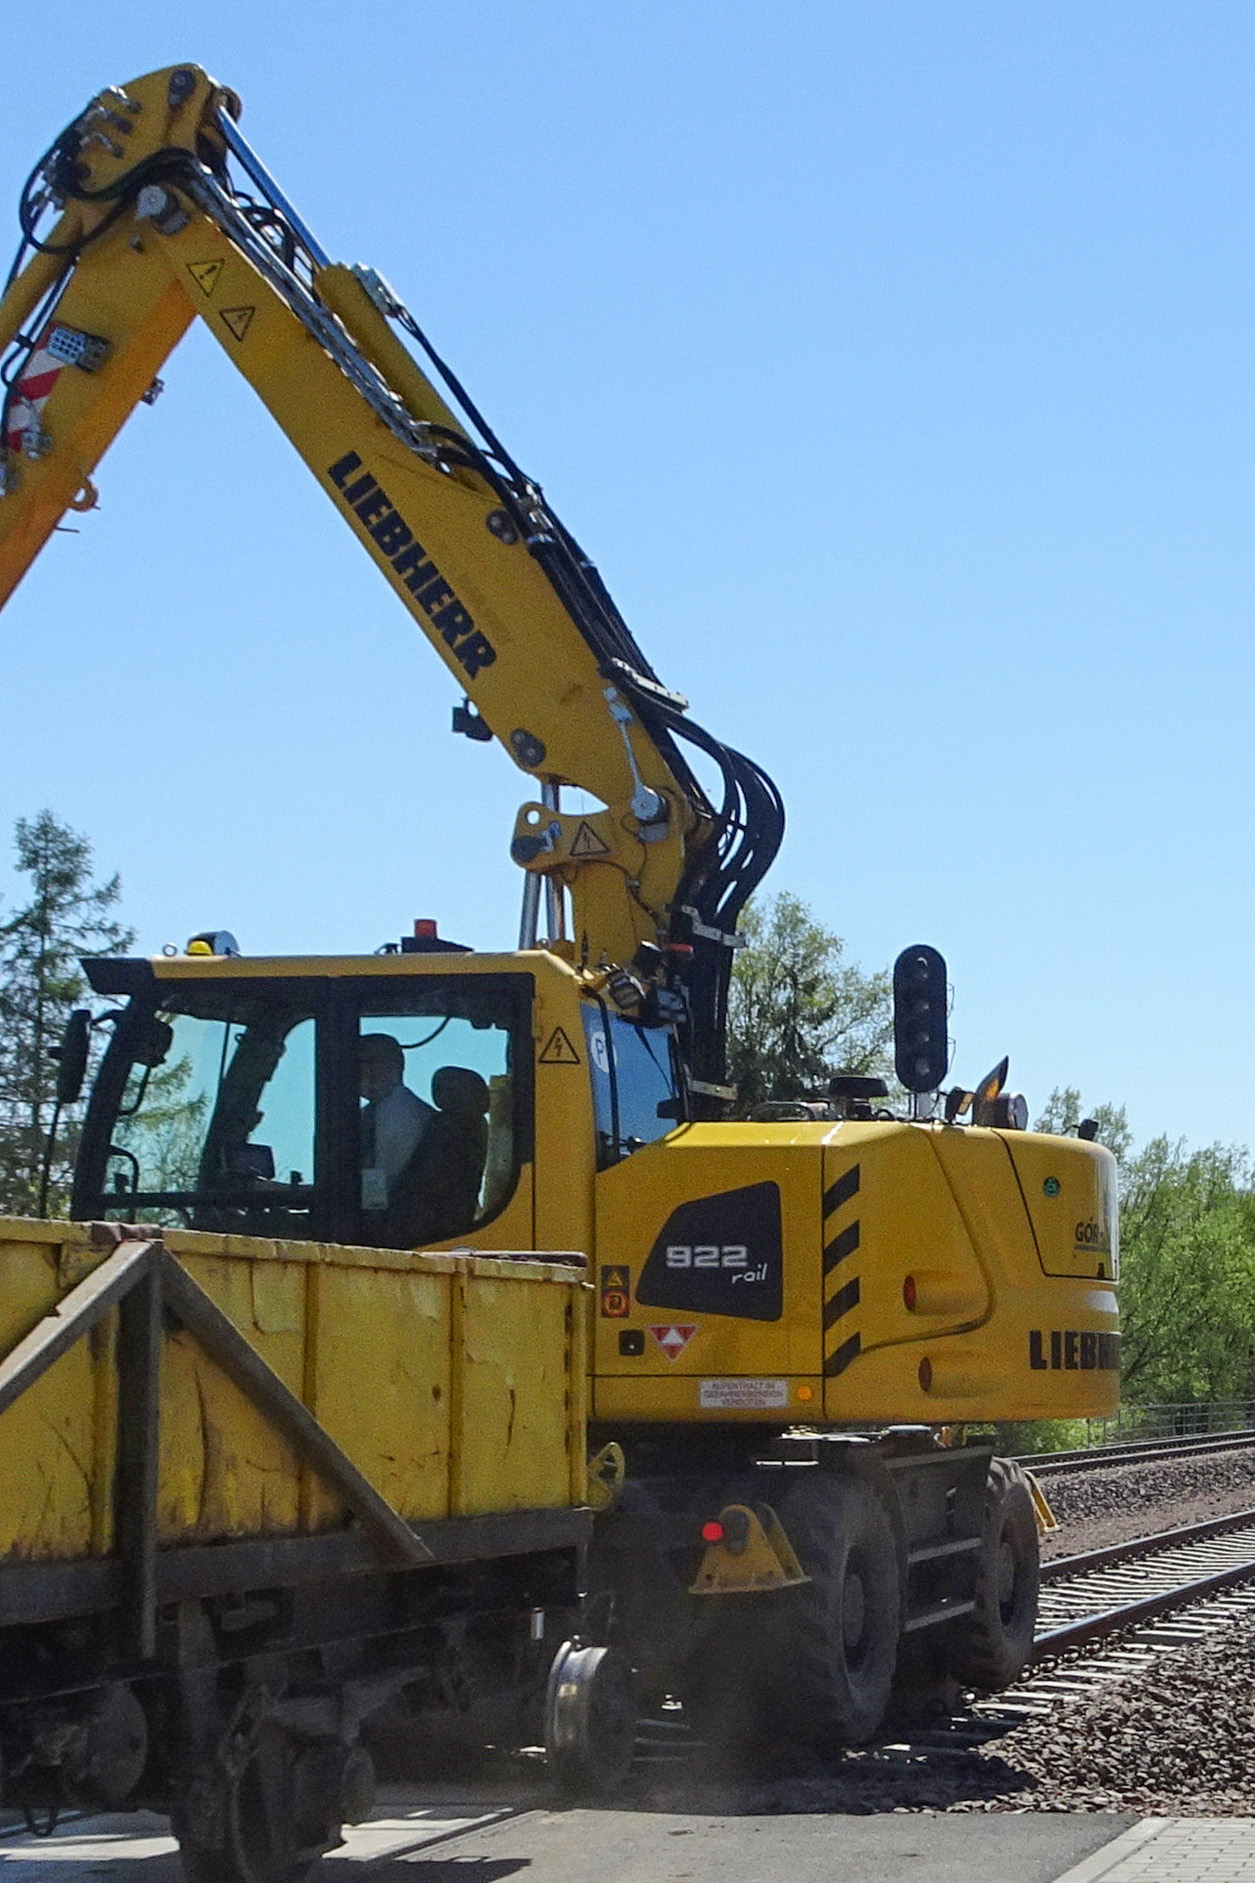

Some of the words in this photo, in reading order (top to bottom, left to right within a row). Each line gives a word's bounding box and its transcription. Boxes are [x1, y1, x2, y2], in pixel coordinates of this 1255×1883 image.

[328, 450, 497, 680] LIEBHERR
[666, 1245, 748, 1268] 922
[731, 1263, 768, 1284] rail
